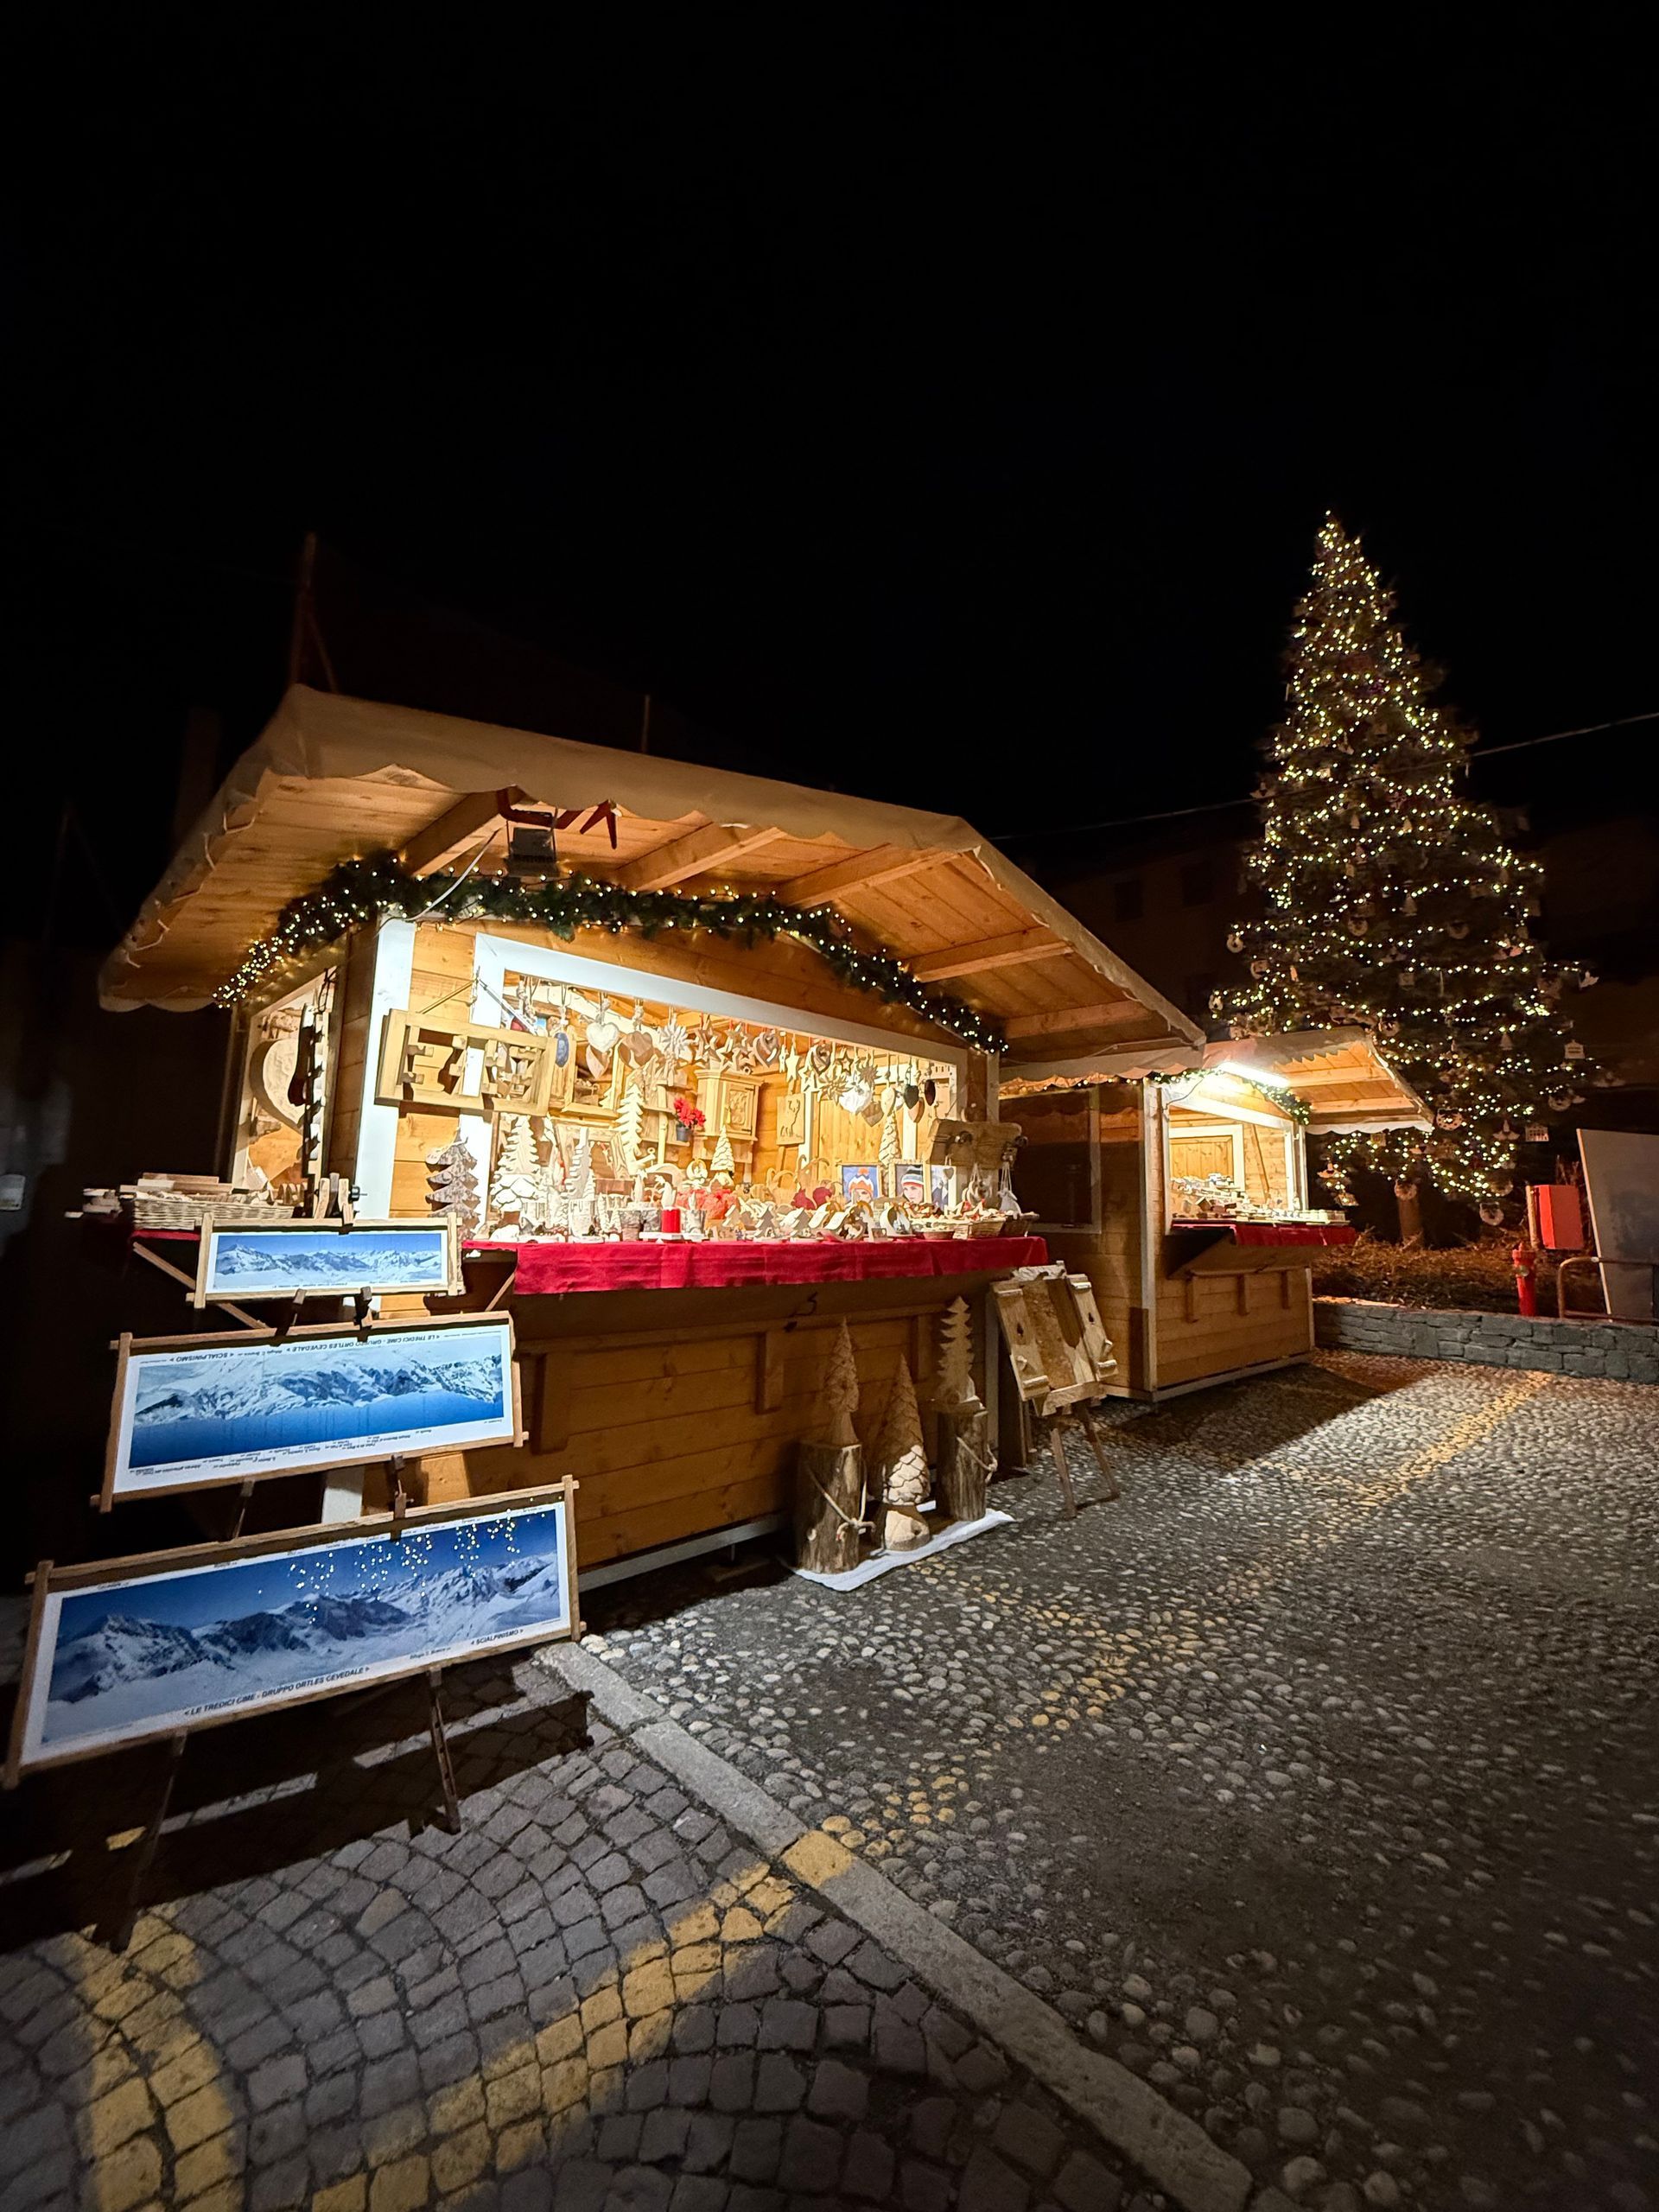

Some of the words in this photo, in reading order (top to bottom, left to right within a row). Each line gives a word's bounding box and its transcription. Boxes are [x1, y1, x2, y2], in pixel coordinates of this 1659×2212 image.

[292, 1344, 327, 1352] CEVEDALE
[175, 1352, 228, 1363] SCIALPINISMO
[475, 1630, 520, 1645] SCIALPINISMO
[204, 1699, 236, 1713] TREDICI
[262, 1684, 296, 1699] GRUPPO
[296, 1676, 325, 1690] ORTLES
[326, 1666, 365, 1682] CEVEDALE
